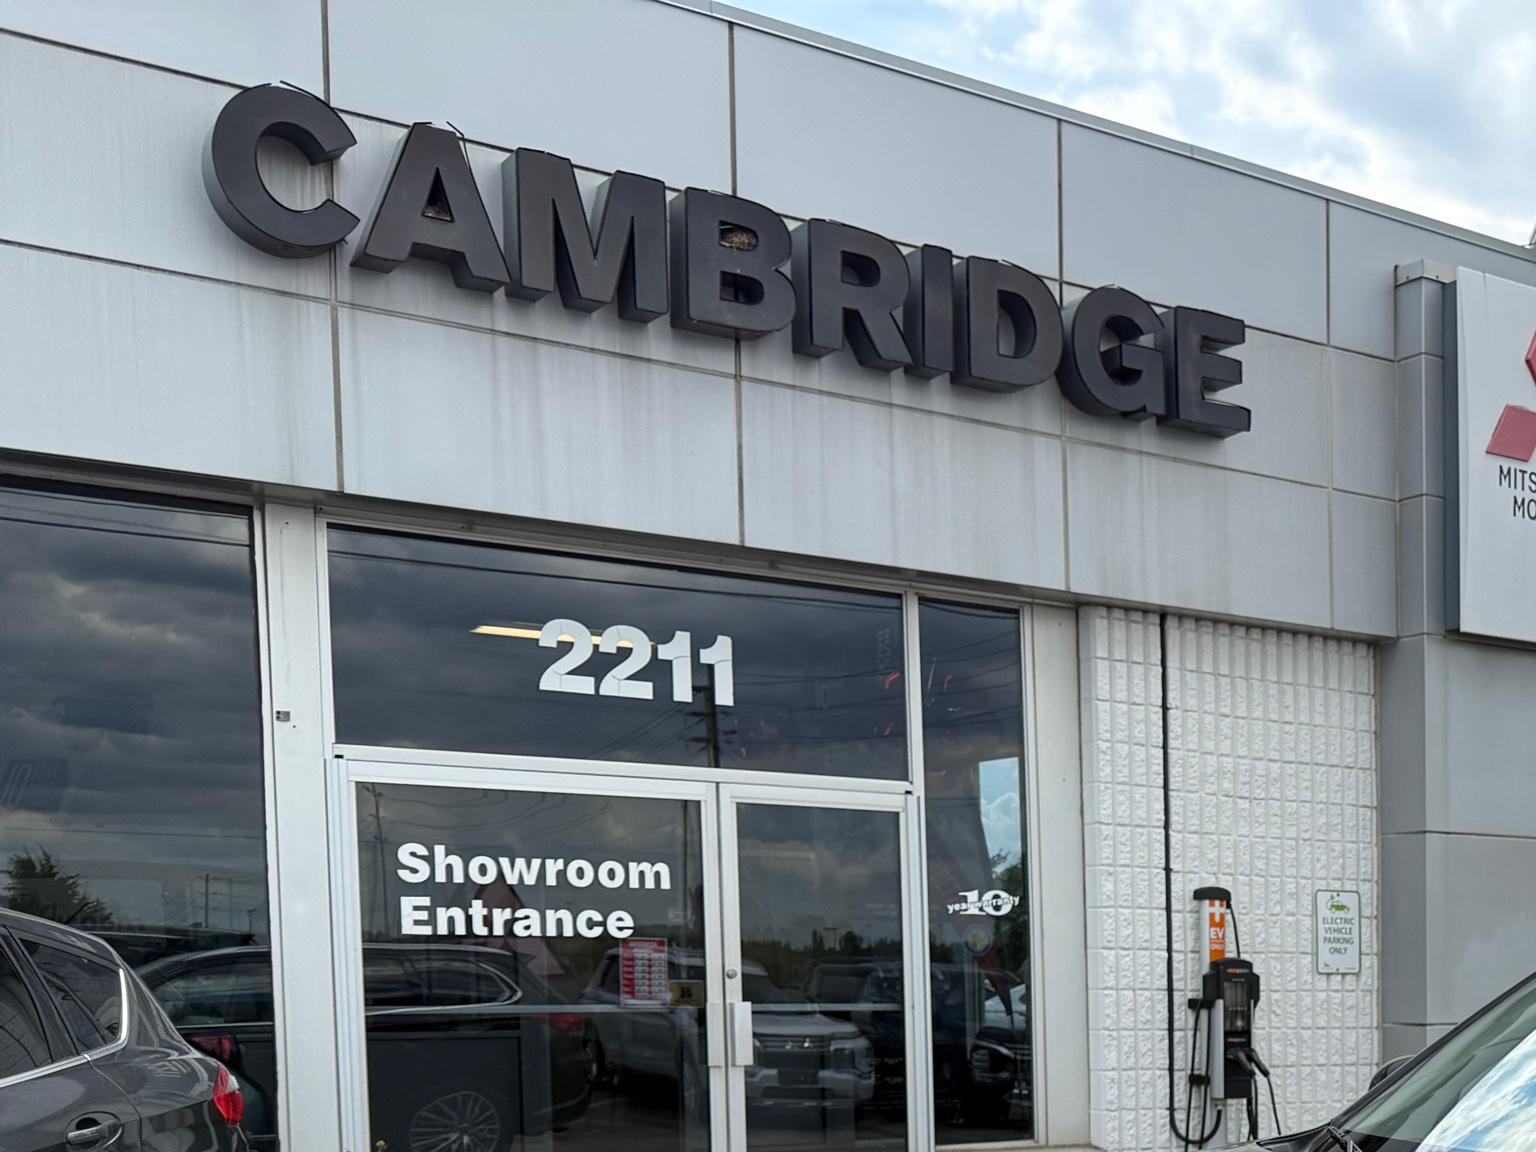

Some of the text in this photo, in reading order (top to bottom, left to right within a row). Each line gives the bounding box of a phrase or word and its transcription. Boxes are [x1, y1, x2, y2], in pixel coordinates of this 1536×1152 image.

[203, 84, 1251, 437] CAMBRIDGE
[538, 618, 735, 707] 2211
[396, 842, 671, 891] Showroom
[958, 889, 1013, 916] 10
[399, 896, 635, 940] Entrance
[1322, 917, 1355, 926] ELECTRIC
[1210, 927, 1225, 939] EV
[1324, 927, 1353, 935] VEHICLE
[1323, 937, 1354, 945] PARKING
[1329, 947, 1348, 955] ONLY
